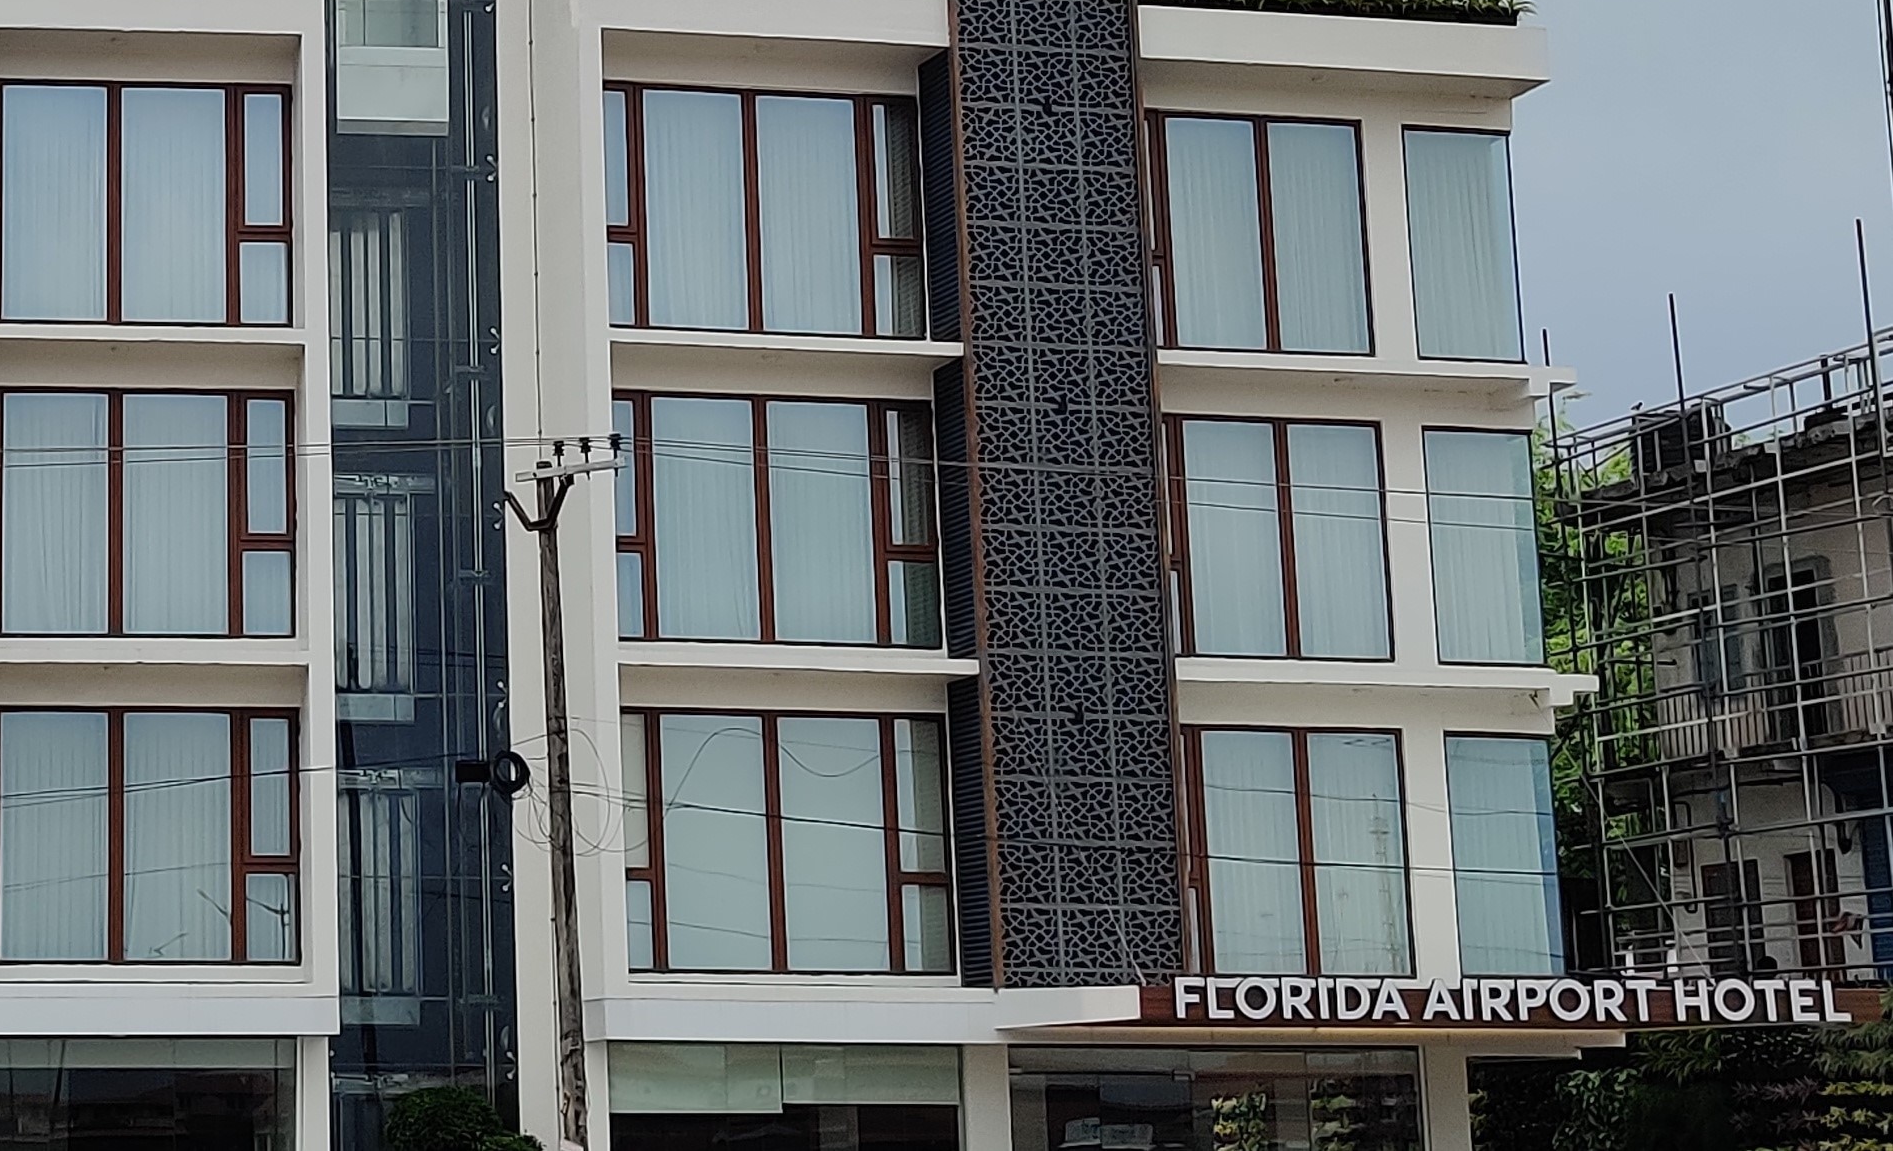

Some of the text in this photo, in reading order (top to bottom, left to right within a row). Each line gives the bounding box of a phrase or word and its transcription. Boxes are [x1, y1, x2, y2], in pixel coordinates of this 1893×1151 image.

[1173, 976, 1853, 1023] FLORIDA AIRPORT HOTEL
